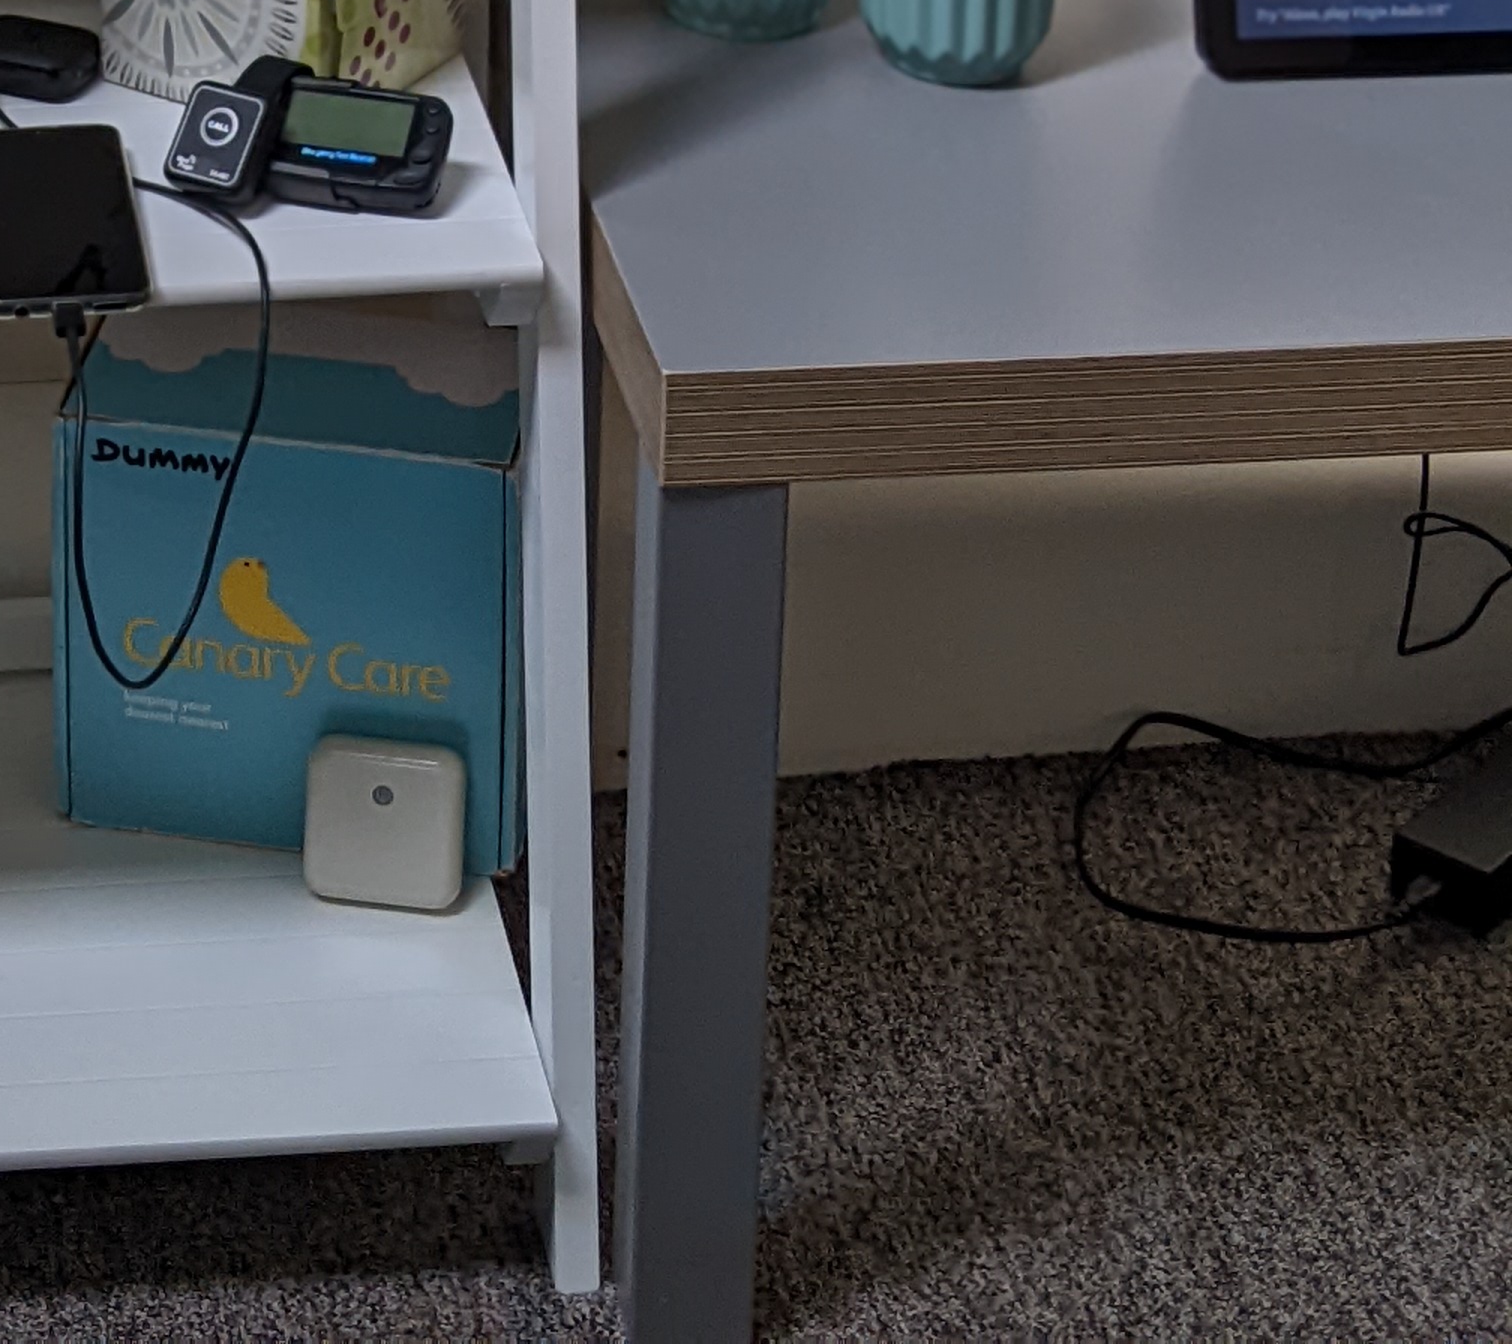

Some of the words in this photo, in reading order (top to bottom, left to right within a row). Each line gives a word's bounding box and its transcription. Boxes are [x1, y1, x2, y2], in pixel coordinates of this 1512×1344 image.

[91, 437, 231, 482] DUMMY
[123, 618, 318, 698] Canary
[328, 643, 452, 703] Care
